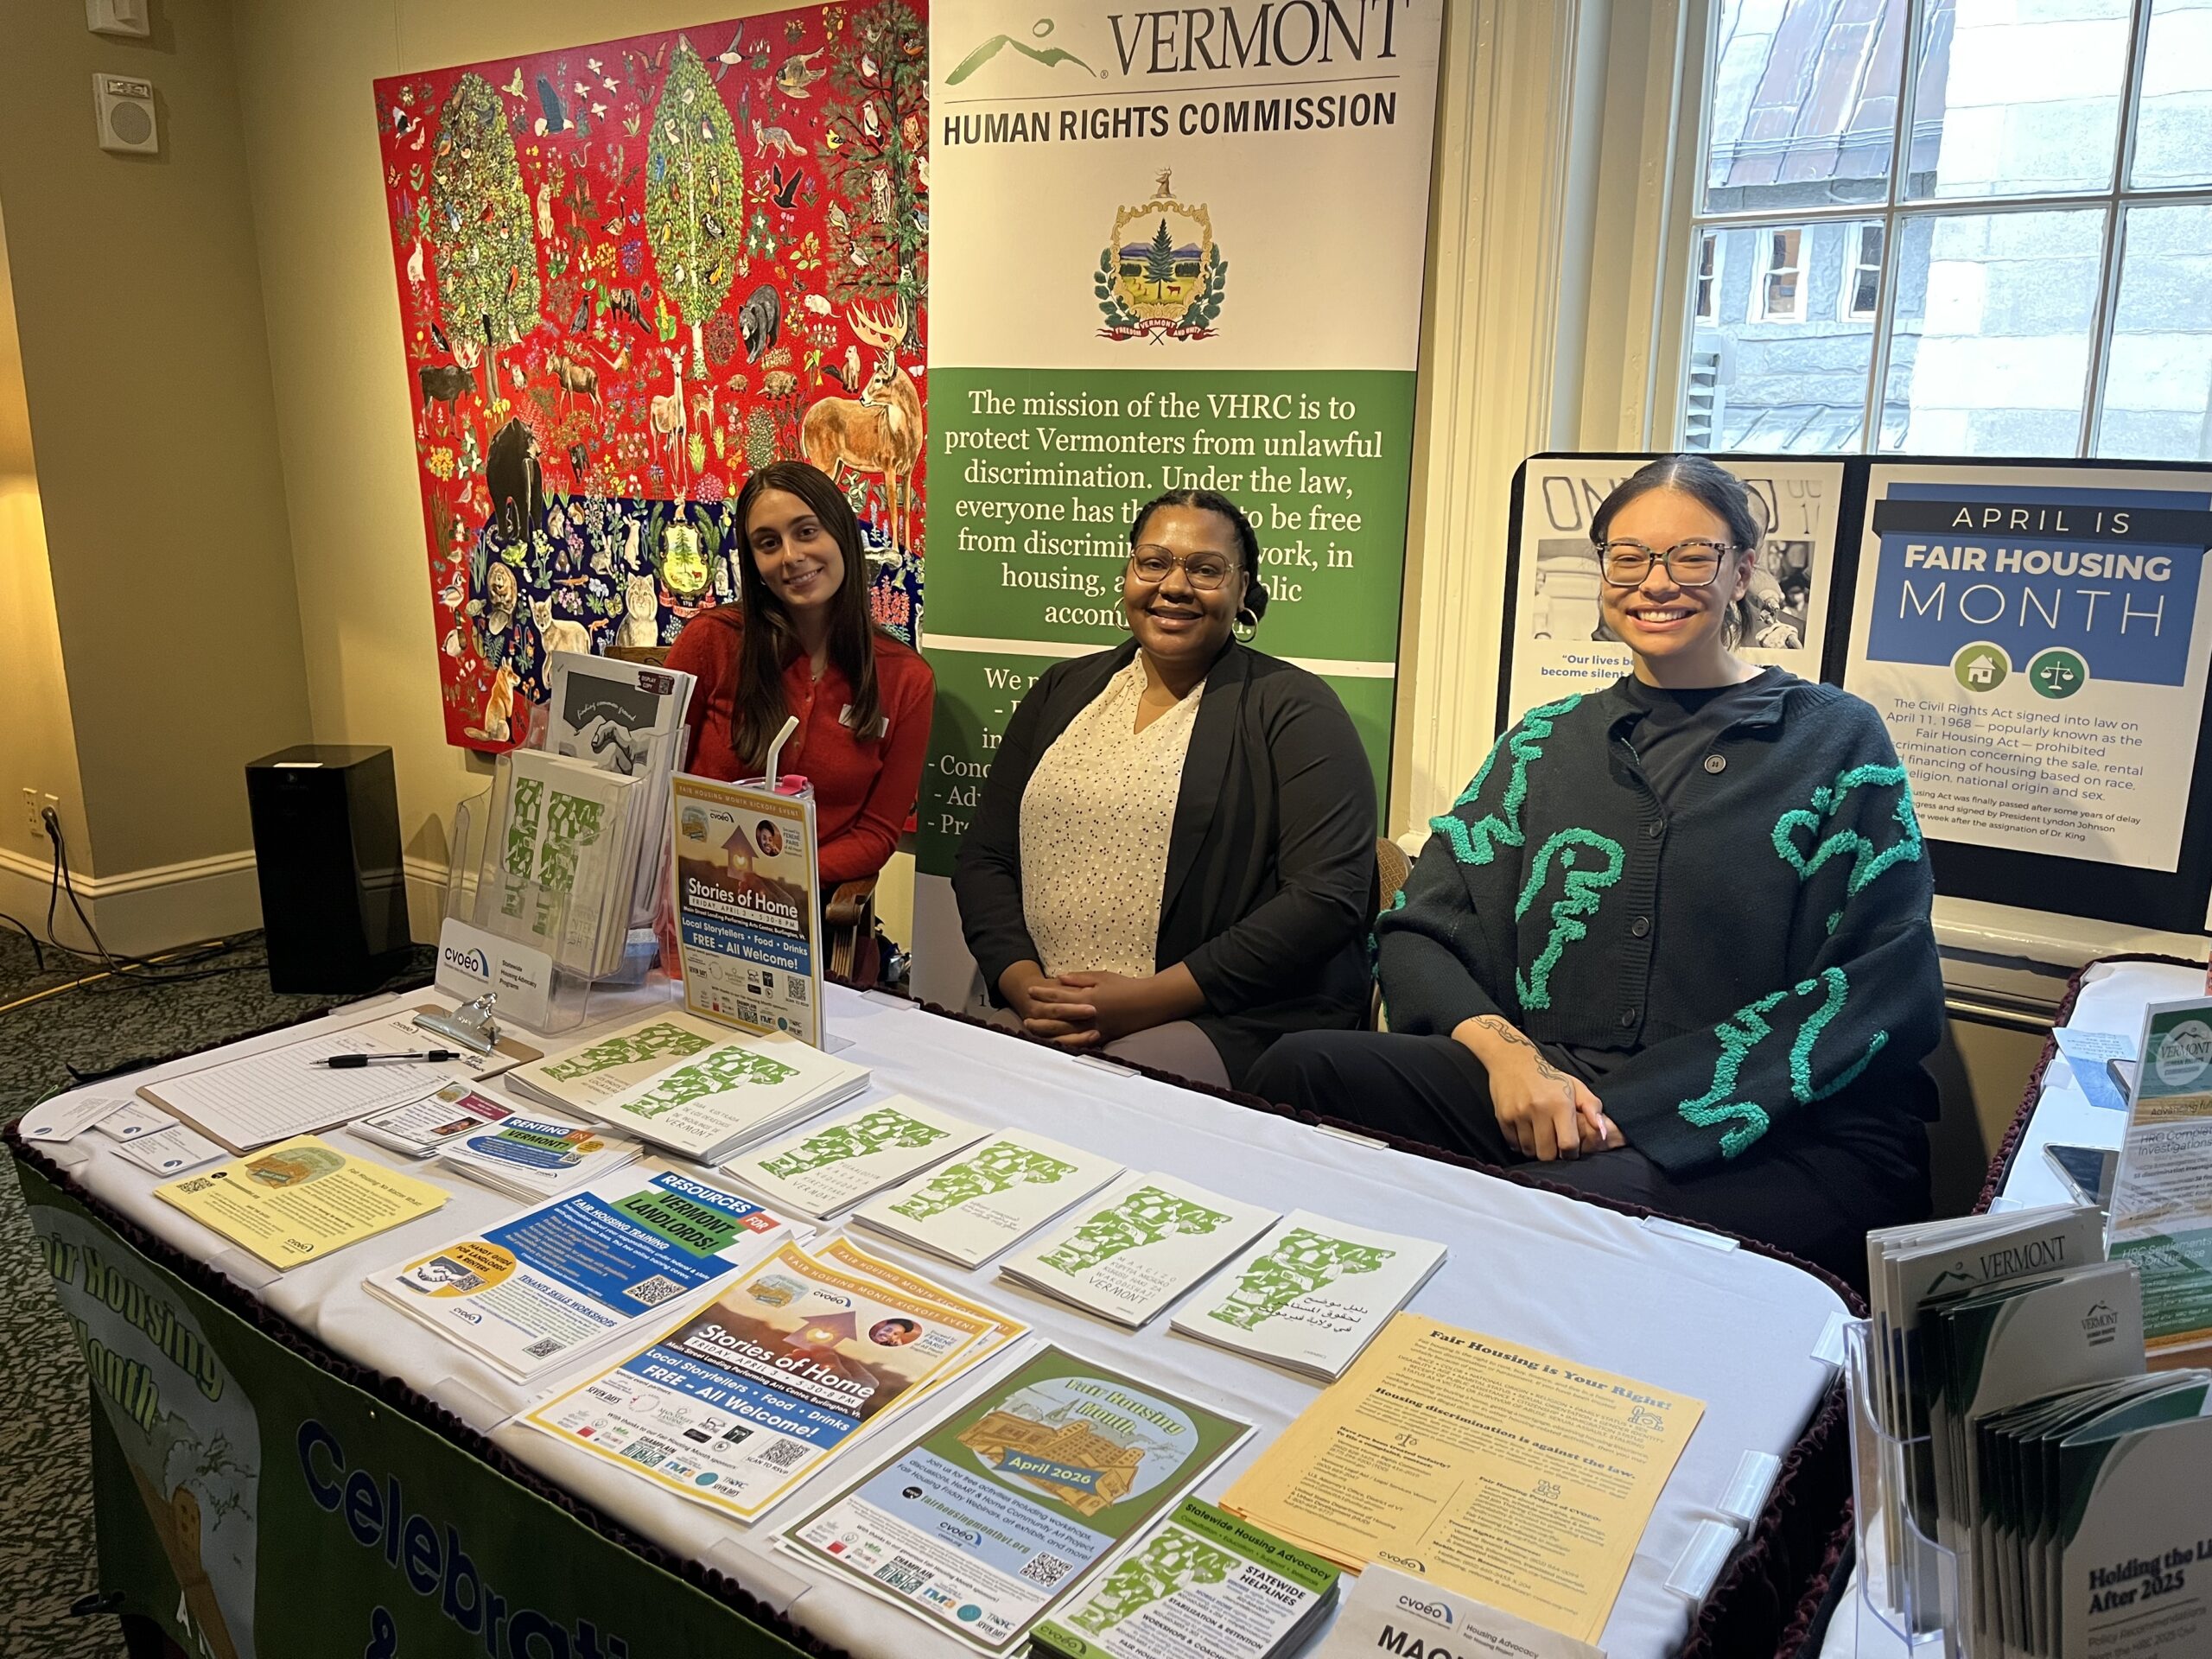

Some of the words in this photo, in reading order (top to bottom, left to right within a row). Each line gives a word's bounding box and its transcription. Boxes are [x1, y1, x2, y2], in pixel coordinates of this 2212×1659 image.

[1107, 0, 1410, 75] VERMONT
[944, 111, 1051, 145] HUMAN
[1060, 105, 1168, 140] RIGHTS
[1179, 92, 1395, 135] COMMISSION
[1141, 319, 1176, 328] VERMONT
[969, 390, 1015, 414] The
[1023, 391, 1120, 417] mission
[1128, 392, 1154, 417] of
[1160, 392, 1199, 418] the
[1207, 394, 1292, 419] VHRC
[1299, 393, 1320, 419] is
[1329, 397, 1355, 420] to
[944, 429, 1029, 454] protect
[1036, 428, 1185, 454] Vermonters
[1192, 429, 1255, 455] from
[1264, 430, 1382, 458] unlawful
[965, 459, 1152, 489] discrimination.
[1162, 466, 1243, 491] Under
[1250, 467, 1292, 493] the
[1299, 467, 1353, 499] law,
[956, 499, 1065, 524] everyone
[1071, 498, 1114, 524] has
[1271, 504, 1301, 530] be
[1309, 505, 1361, 531] free
[1952, 507, 2069, 531] APRIL
[2095, 512, 2130, 534] IS
[958, 527, 1016, 553] from
[1327, 542, 1354, 568] in
[1904, 544, 1986, 571] FAIR
[1995, 549, 2172, 582] HOUSING
[1002, 563, 1105, 597] housing,
[1900, 580, 2164, 637] MONTH
[1541, 667, 1588, 677] become
[1591, 669, 1624, 678] silent
[1592, 655, 1619, 665] lives
[1886, 712, 1915, 724] April
[1942, 717, 1972, 728] 1968
[1988, 723, 2050, 739] popularly
[2053, 728, 2098, 741] known
[2101, 734, 2116, 744] as
[2120, 735, 2143, 746] the
[1895, 699, 1916, 709] The
[1919, 701, 1944, 712] Civil
[1948, 703, 1987, 716] Rights
[1992, 708, 2012, 719] Act
[2017, 711, 2060, 723] signed
[2064, 715, 2090, 726] into
[2094, 717, 2119, 729] law
[2121, 721, 2139, 732] on
[1916, 728, 1938, 739] Fair
[1942, 732, 1993, 747] Housing
[1997, 737, 2018, 748] Act
[2036, 741, 2106, 757] prohibited
[1908, 755, 1966, 772] financing
[1969, 762, 1983, 772] of
[1985, 764, 2037, 780] housing
[2041, 770, 2080, 783] based
[2084, 776, 2101, 785] on
[1970, 750, 2042, 766] concerning
[2046, 757, 2068, 767] the
[2104, 764, 2144, 777] rental
[1956, 776, 2008, 790] national
[2012, 781, 2049, 795] origin
[2052, 786, 2078, 798] and
[2082, 791, 2106, 802] sex.
[689, 878, 734, 903] Stories
[738, 890, 752, 907] of
[755, 892, 798, 918] Home
[445, 947, 479, 972] cvoeo
[693, 932, 715, 950] FREE
[727, 942, 741, 956] All
[742, 946, 798, 970] Welcome!
[507, 1129, 569, 1149] VERMONT?
[510, 1119, 569, 1135] RENTING
[570, 1132, 588, 1141] IN
[664, 1116, 715, 1138] VERMONT
[661, 1175, 752, 1213] RESOURCES
[572, 1198, 594, 1211] FAIR
[592, 1208, 632, 1232] HOUSING
[629, 1227, 671, 1250] TRAINING
[624, 1199, 720, 1251] LANDLORDS!
[658, 1194, 736, 1235] VERMONT
[745, 1216, 769, 1230] FOR
[454, 1245, 470, 1256] FOR
[467, 1251, 509, 1273] LANDLORDS
[461, 1256, 492, 1273] RENTERS
[467, 1243, 492, 1256] HANDY
[490, 1252, 514, 1266] GUIDE
[1980, 1235, 2066, 1279] VERMONT
[519, 1274, 549, 1294] TENANTS
[546, 1287, 570, 1306] SKILLS
[569, 1299, 618, 1328] WORKSHOPS
[787, 1255, 809, 1272] FAIR
[810, 1269, 855, 1288] HOUSING
[857, 1286, 893, 1304] MONTH
[896, 1300, 941, 1320] KICKOFF
[943, 1316, 976, 1332] EVENT
[1089, 1276, 1148, 1304] VERMONT
[82, 1244, 225, 1402] Housing
[2082, 1312, 2118, 1332] VERMONT
[691, 1340, 731, 1360] FRIDAY,
[735, 1356, 767, 1373] APRIL
[836, 1395, 856, 1405] PM
[698, 1324, 774, 1361] Stories
[775, 1357, 810, 1372] of
[802, 1363, 875, 1399] Home
[1428, 1330, 1465, 1345] Fair
[1467, 1339, 1540, 1370] Housing
[1543, 1364, 1559, 1376] is
[1563, 1371, 1609, 1391] Your
[1611, 1386, 1673, 1411] Right!
[642, 1365, 686, 1387] FREE
[696, 1385, 721, 1403] All
[726, 1395, 819, 1438] Welcome!
[645, 1349, 681, 1369] Local
[680, 1361, 749, 1394] Storytellers
[761, 1394, 796, 1412] Food
[807, 1410, 850, 1432] Drinks
[1065, 1379, 1109, 1399] Fair
[1105, 1391, 1186, 1436] Housing
[1077, 1401, 1138, 1435] Month
[1375, 1387, 1423, 1412] Housing
[1425, 1401, 1516, 1440] discrimination
[1518, 1434, 1530, 1444] is
[1531, 1439, 1580, 1462] against
[1581, 1454, 1606, 1469] the
[1606, 1460, 1637, 1479] law.
[1008, 1456, 1052, 1476] April
[1051, 1467, 1091, 1485] 2026
[920, 1495, 1032, 1554] fairhousingmonthvt.org
[1185, 1503, 1235, 1533] Statewide
[1234, 1527, 1278, 1554] Housing
[1276, 1548, 1332, 1581] Advocacy
[1245, 1565, 1307, 1600] STATEWIDE
[2088, 1556, 2161, 1591] Holding
[2164, 1548, 2193, 1569] the
[1239, 1573, 1298, 1607] HELPLINES
[1398, 1594, 1442, 1619] cvoeo
[2088, 1588, 2138, 1615] After
[2140, 1568, 2184, 1600] 2025
[1142, 1613, 1188, 1643] WORKSHOPS
[1465, 1624, 1498, 1643] Housing
[1497, 1637, 1540, 1658] Advocacy
